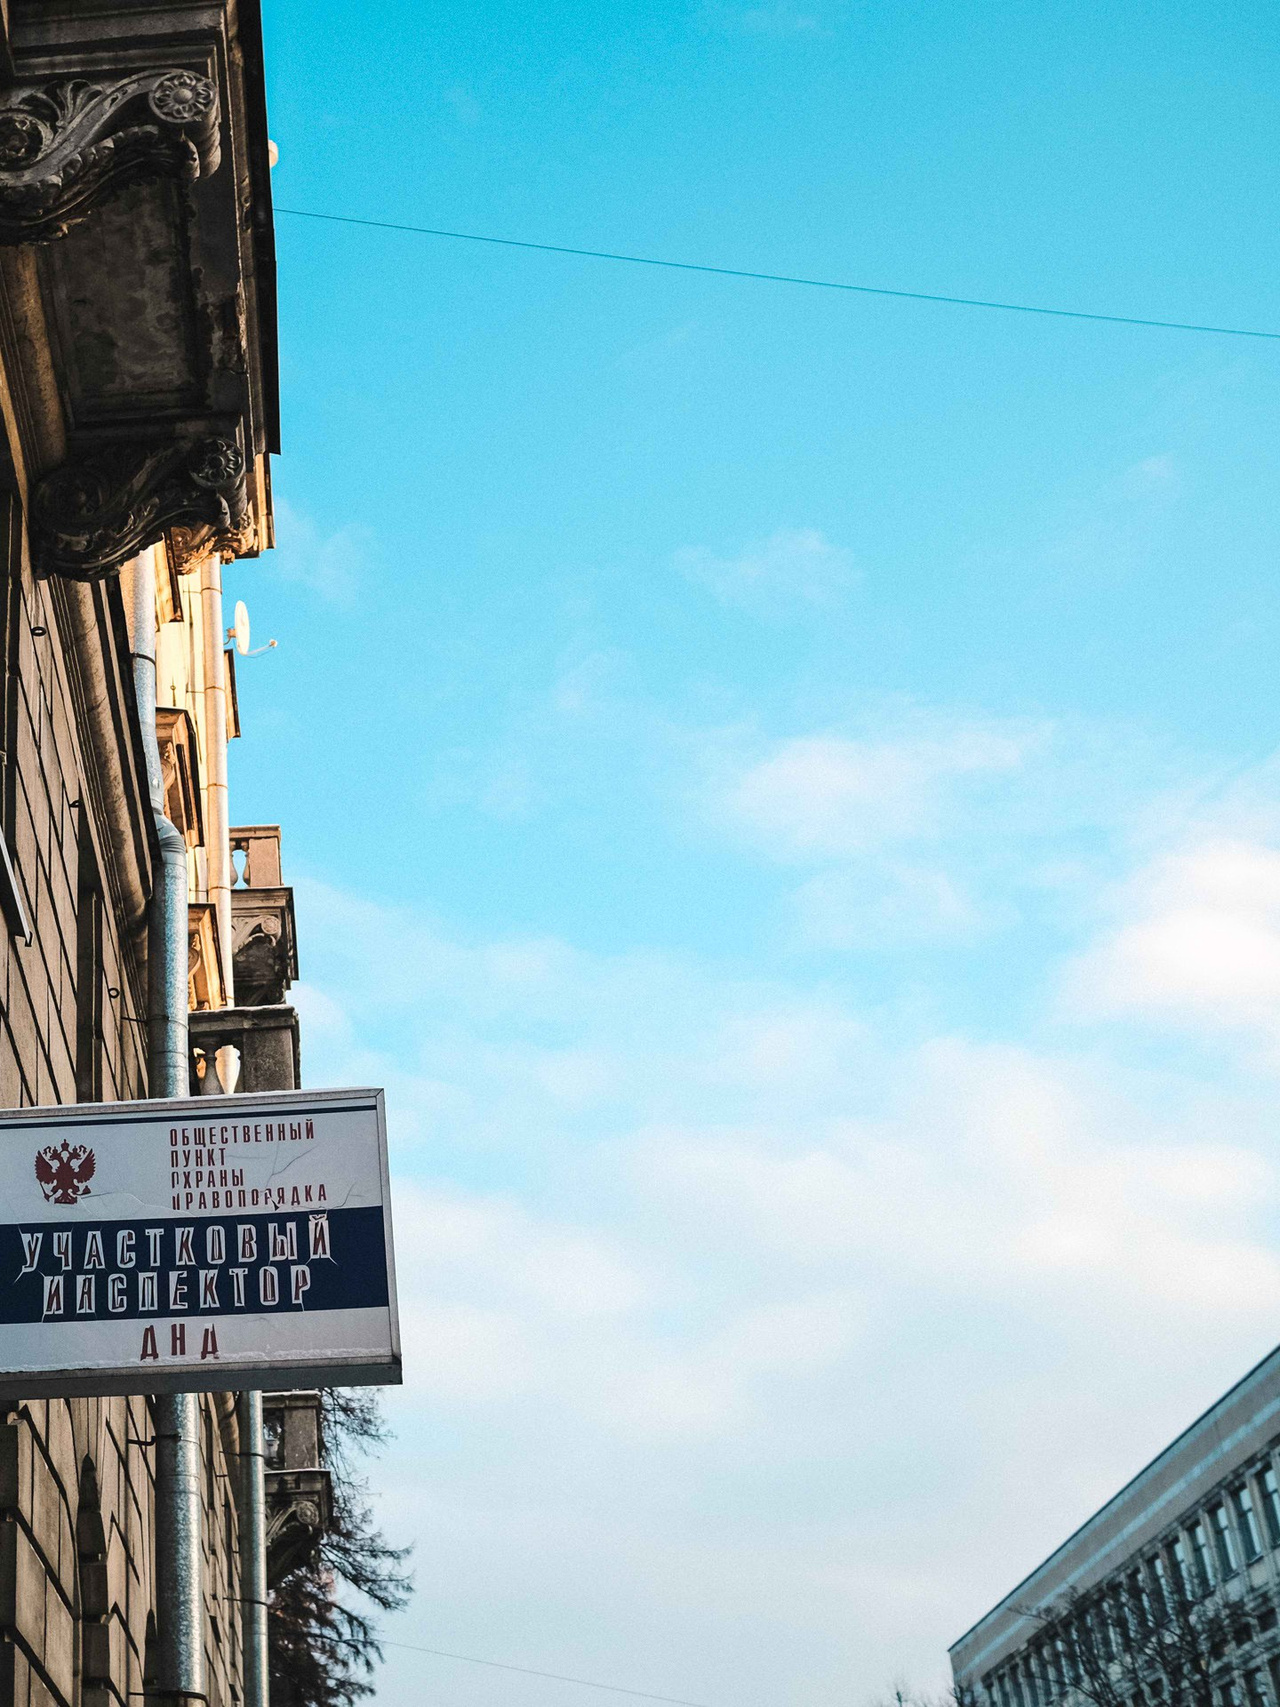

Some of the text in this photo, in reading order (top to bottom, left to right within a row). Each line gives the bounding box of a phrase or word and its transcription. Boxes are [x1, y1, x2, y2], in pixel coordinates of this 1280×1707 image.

[169, 1118, 315, 1148] ОБЩЕСТВЕННЫЙ
[170, 1147, 227, 1168] ПУНКТ
[20, 1213, 332, 1273] УЧАСТКОВЫЙ
[42, 1264, 314, 1315] ИНСПЕКТОР
[139, 1322, 220, 1361] ДНД
